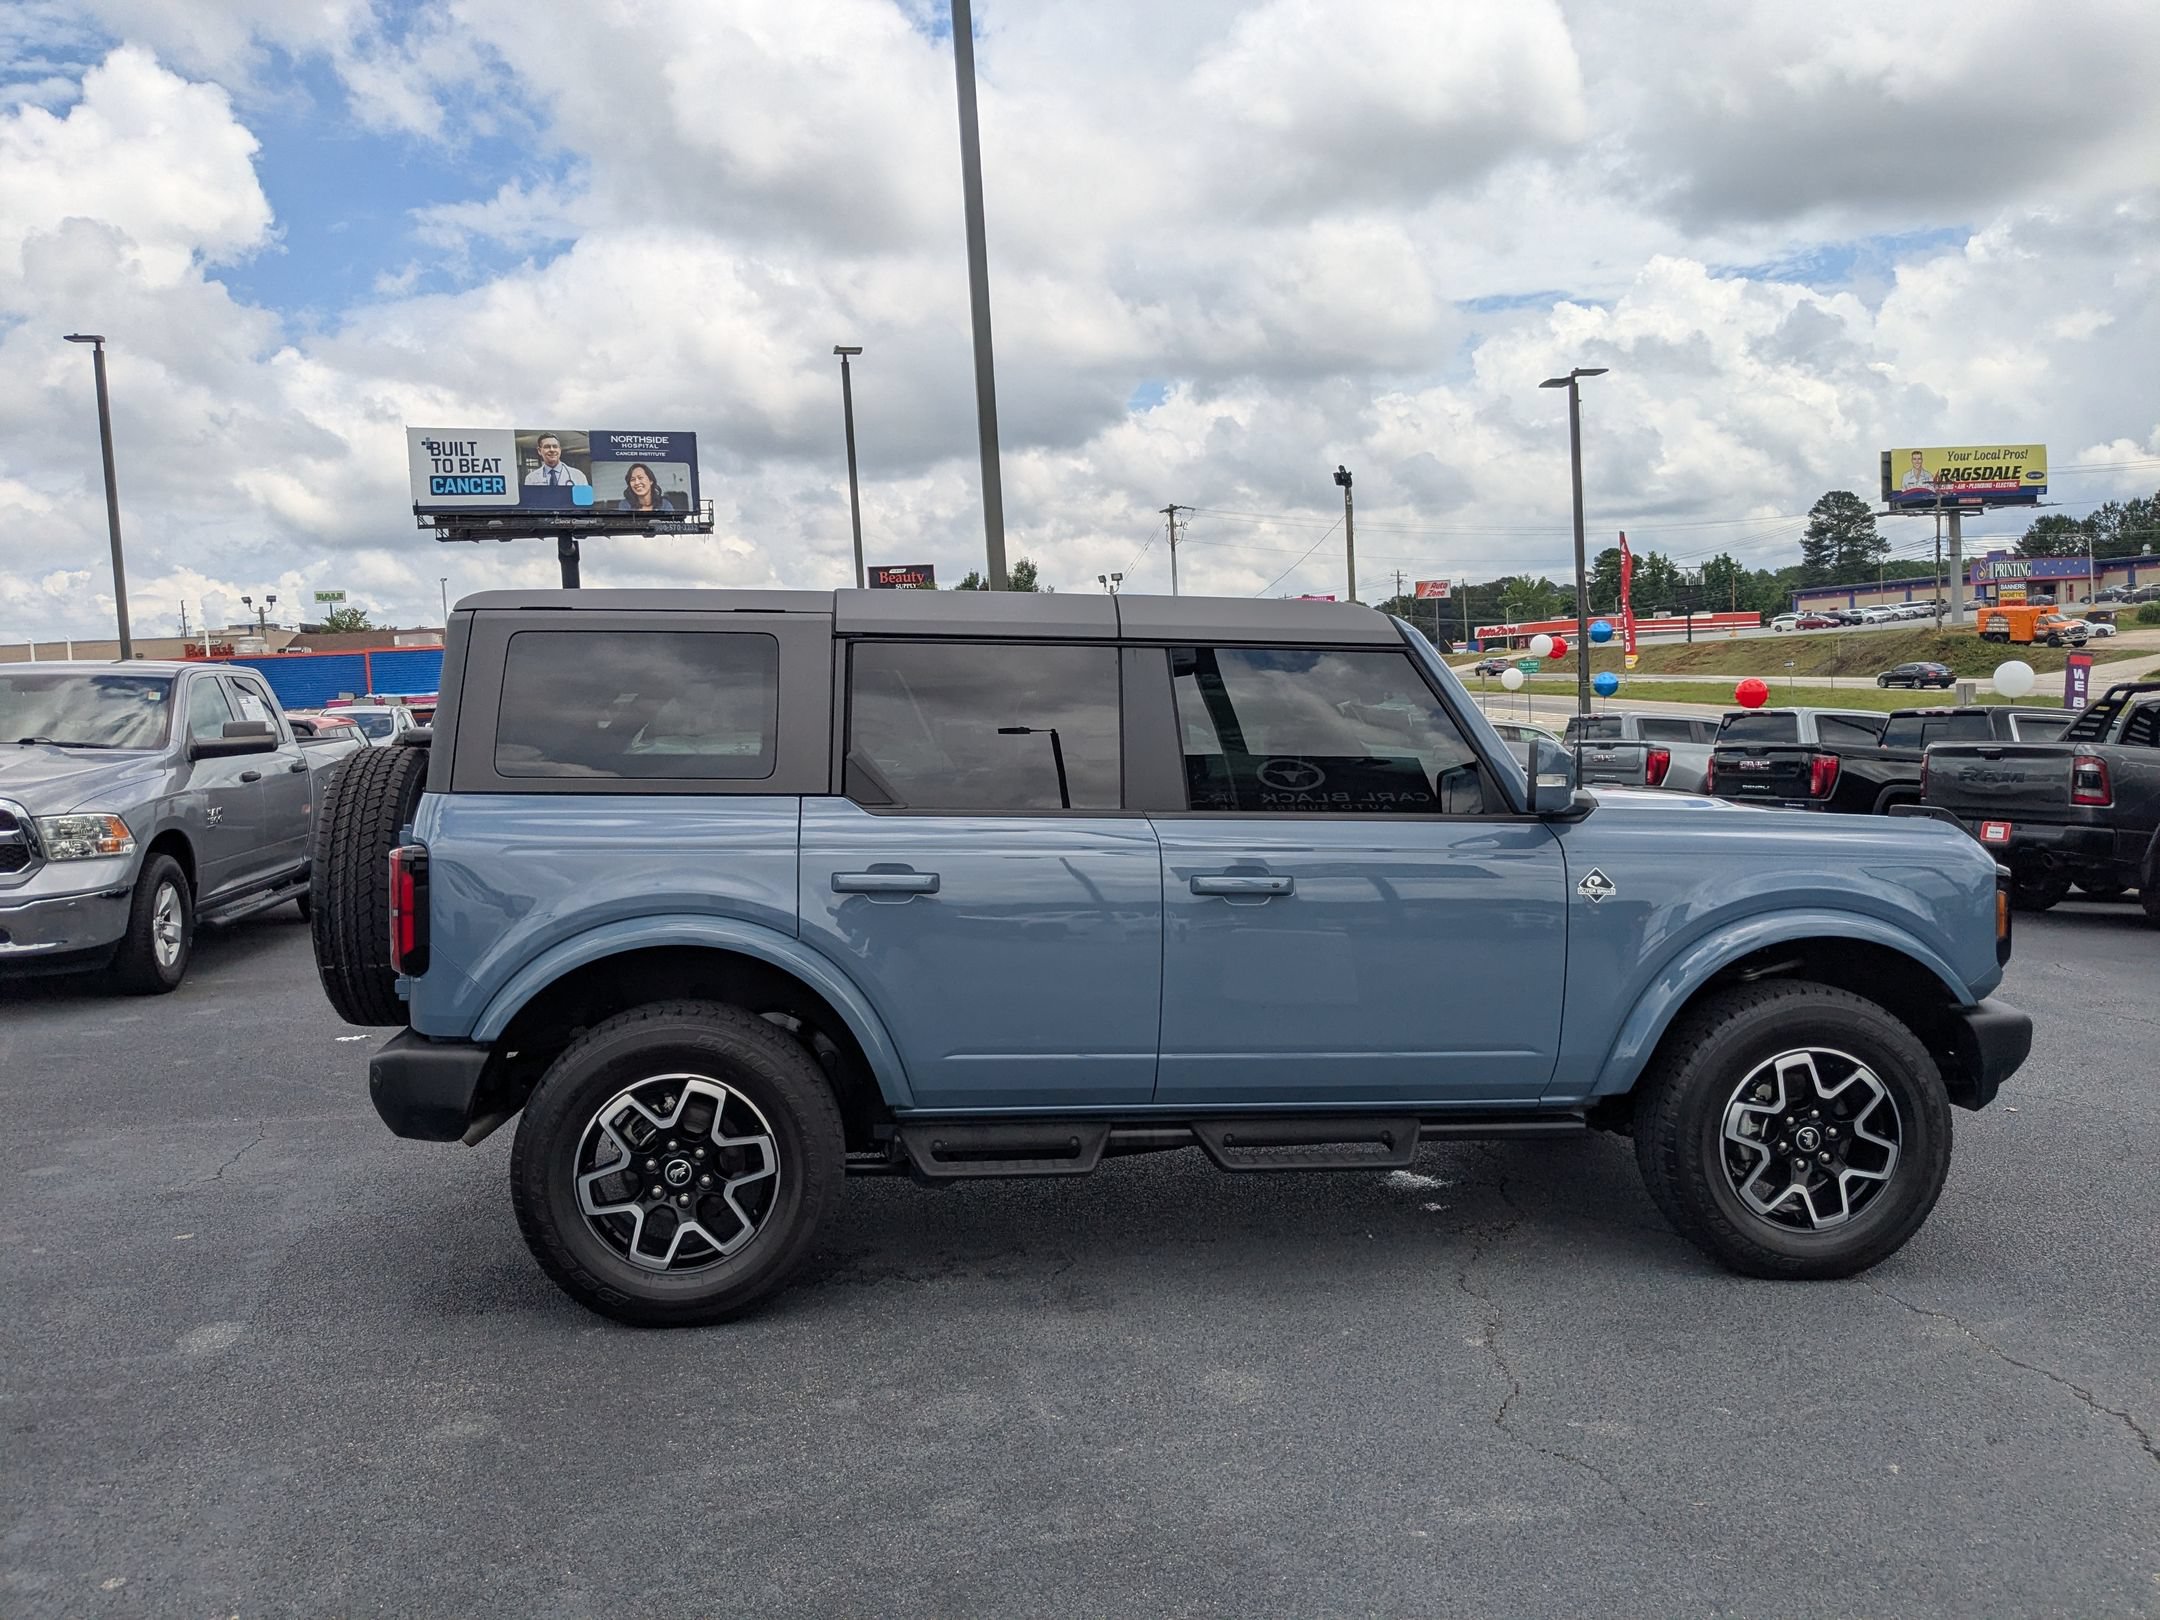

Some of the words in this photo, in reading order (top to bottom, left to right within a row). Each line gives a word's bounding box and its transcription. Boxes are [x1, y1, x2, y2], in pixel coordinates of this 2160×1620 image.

[610, 435, 669, 444] NORTHSIDE
[430, 441, 477, 456] BUILT
[1947, 450, 1972, 462] Your
[1974, 449, 2000, 460] Local
[2003, 448, 2029, 460] Pros!
[431, 458, 453, 473] TO
[460, 458, 501, 473] BEAT
[1940, 465, 2022, 482] RAGSDALE
[432, 477, 505, 493] CANCER
[1995, 481, 2017, 489] ELECTRIC
[1994, 563, 2031, 577] PRINTING
[879, 571, 924, 585] Beauty
[1477, 626, 1516, 637] AutoZone
[2073, 669, 2085, 691] WE
[1740, 760, 1770, 770] GMC
[1958, 770, 2025, 783] RAM
